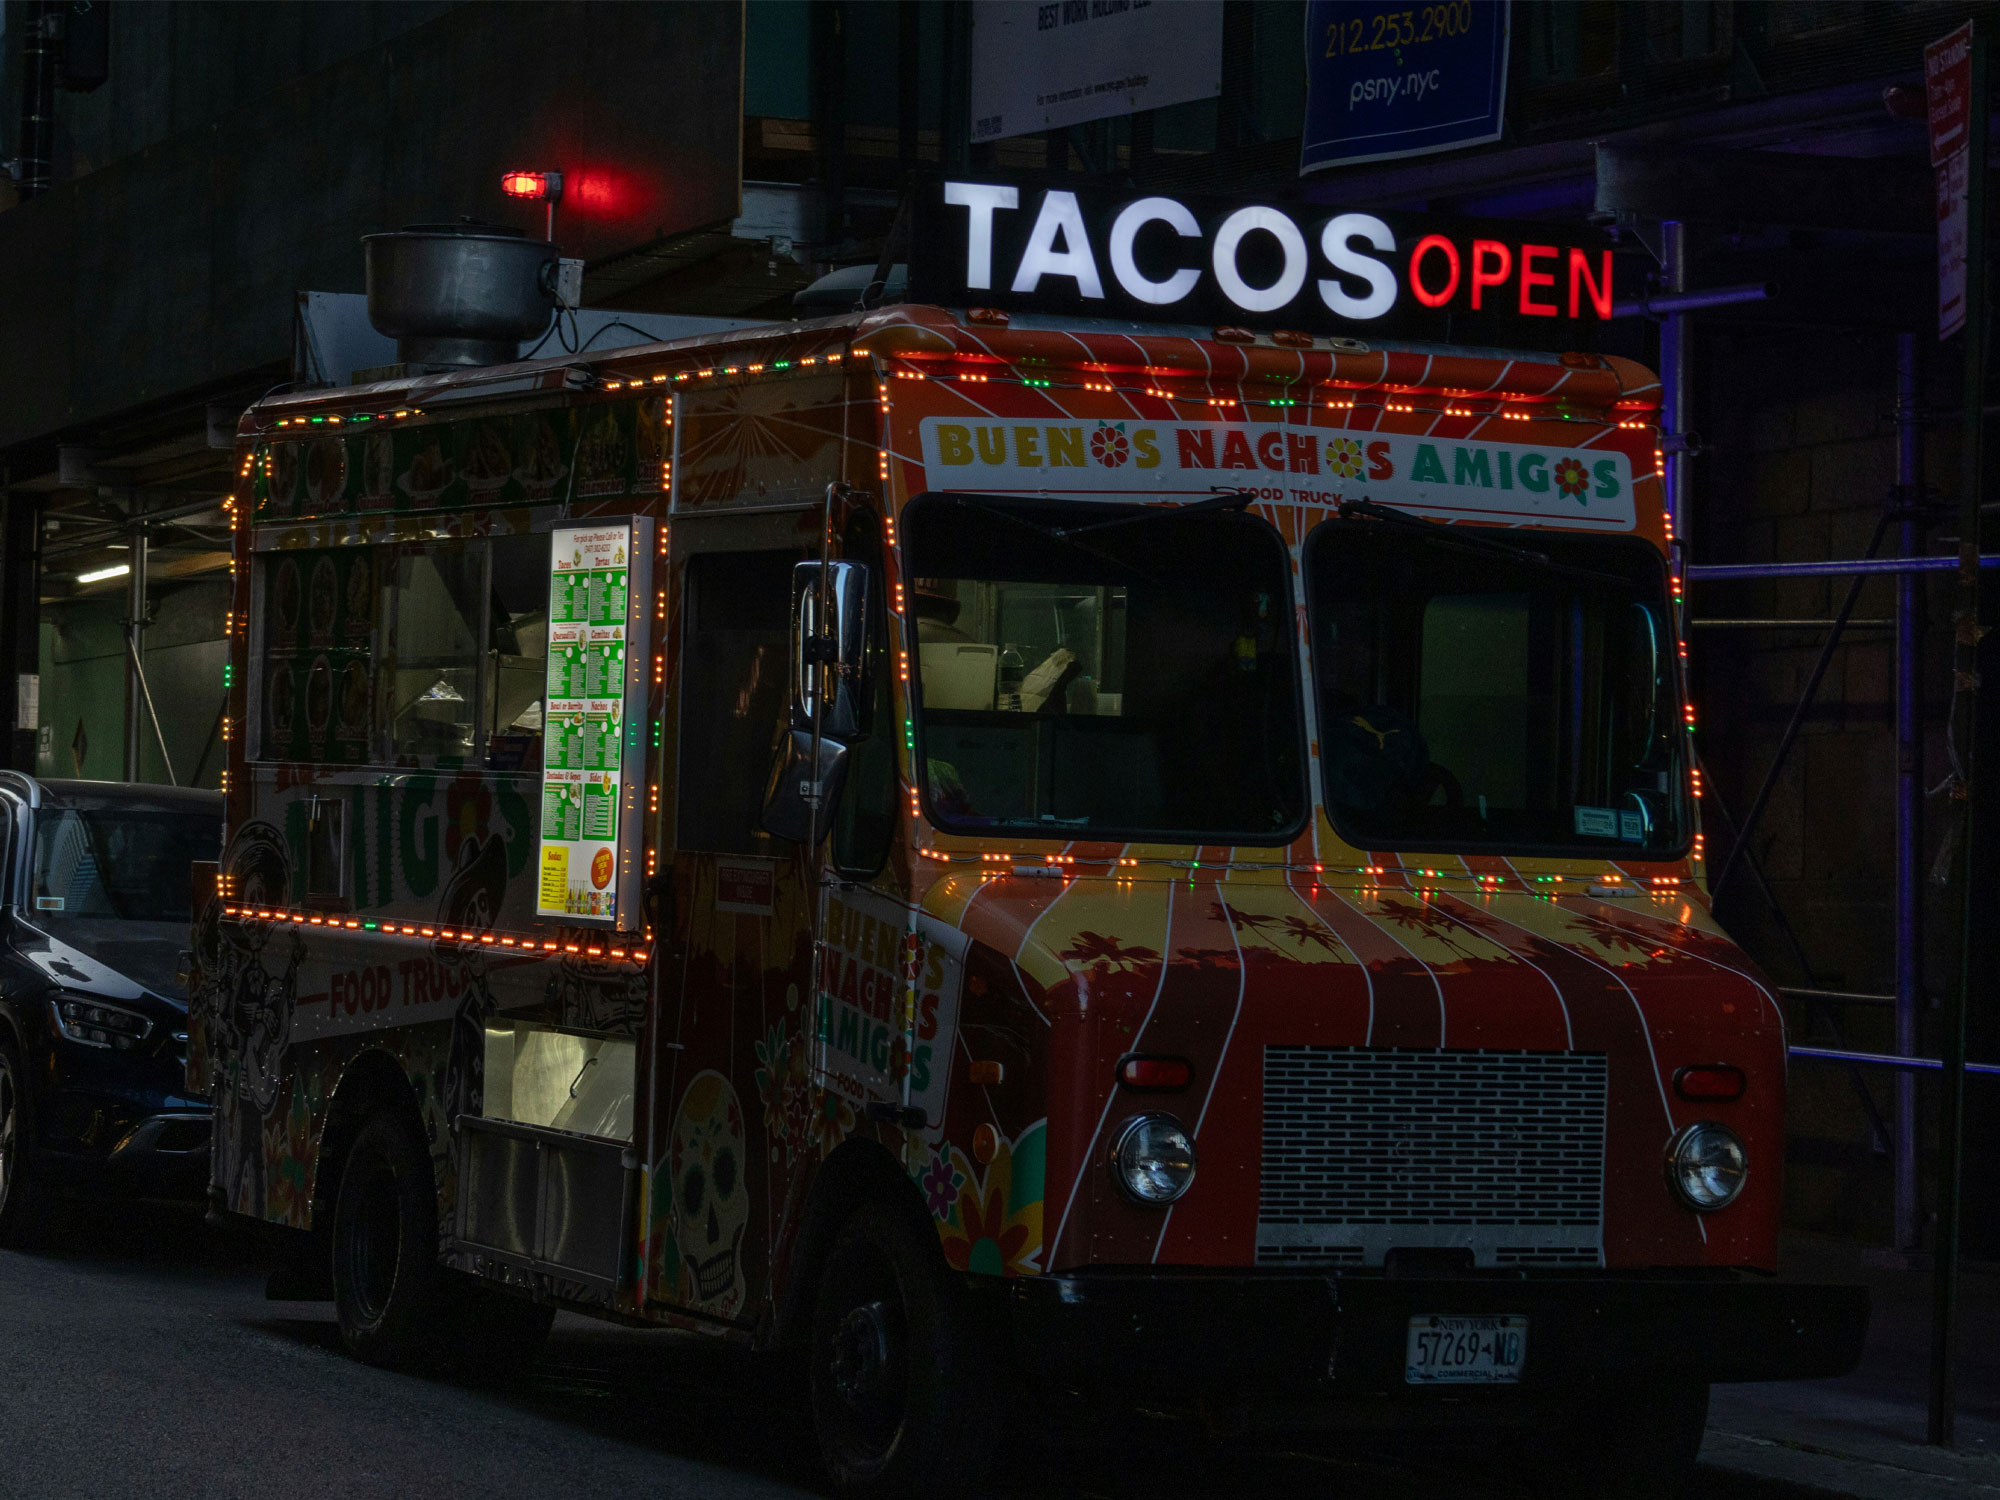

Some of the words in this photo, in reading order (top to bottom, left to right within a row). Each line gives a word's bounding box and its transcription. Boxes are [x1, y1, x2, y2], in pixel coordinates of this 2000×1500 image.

[1038, 3, 1059, 31] BEST
[1325, 0, 1472, 59] 212.253.2900
[1349, 69, 1440, 111] psny.nyc
[944, 182, 1398, 320] TACOS
[1409, 234, 1614, 320] OPEN
[1290, 489, 1344, 507] TRUCK
[330, 965, 392, 1018] FOOD
[1440, 1319, 1465, 1330] NEW
[1468, 1319, 1499, 1331] YORK
[1416, 1332, 1480, 1366] 57269
[1438, 1370, 1491, 1378] COMMERCIAL
